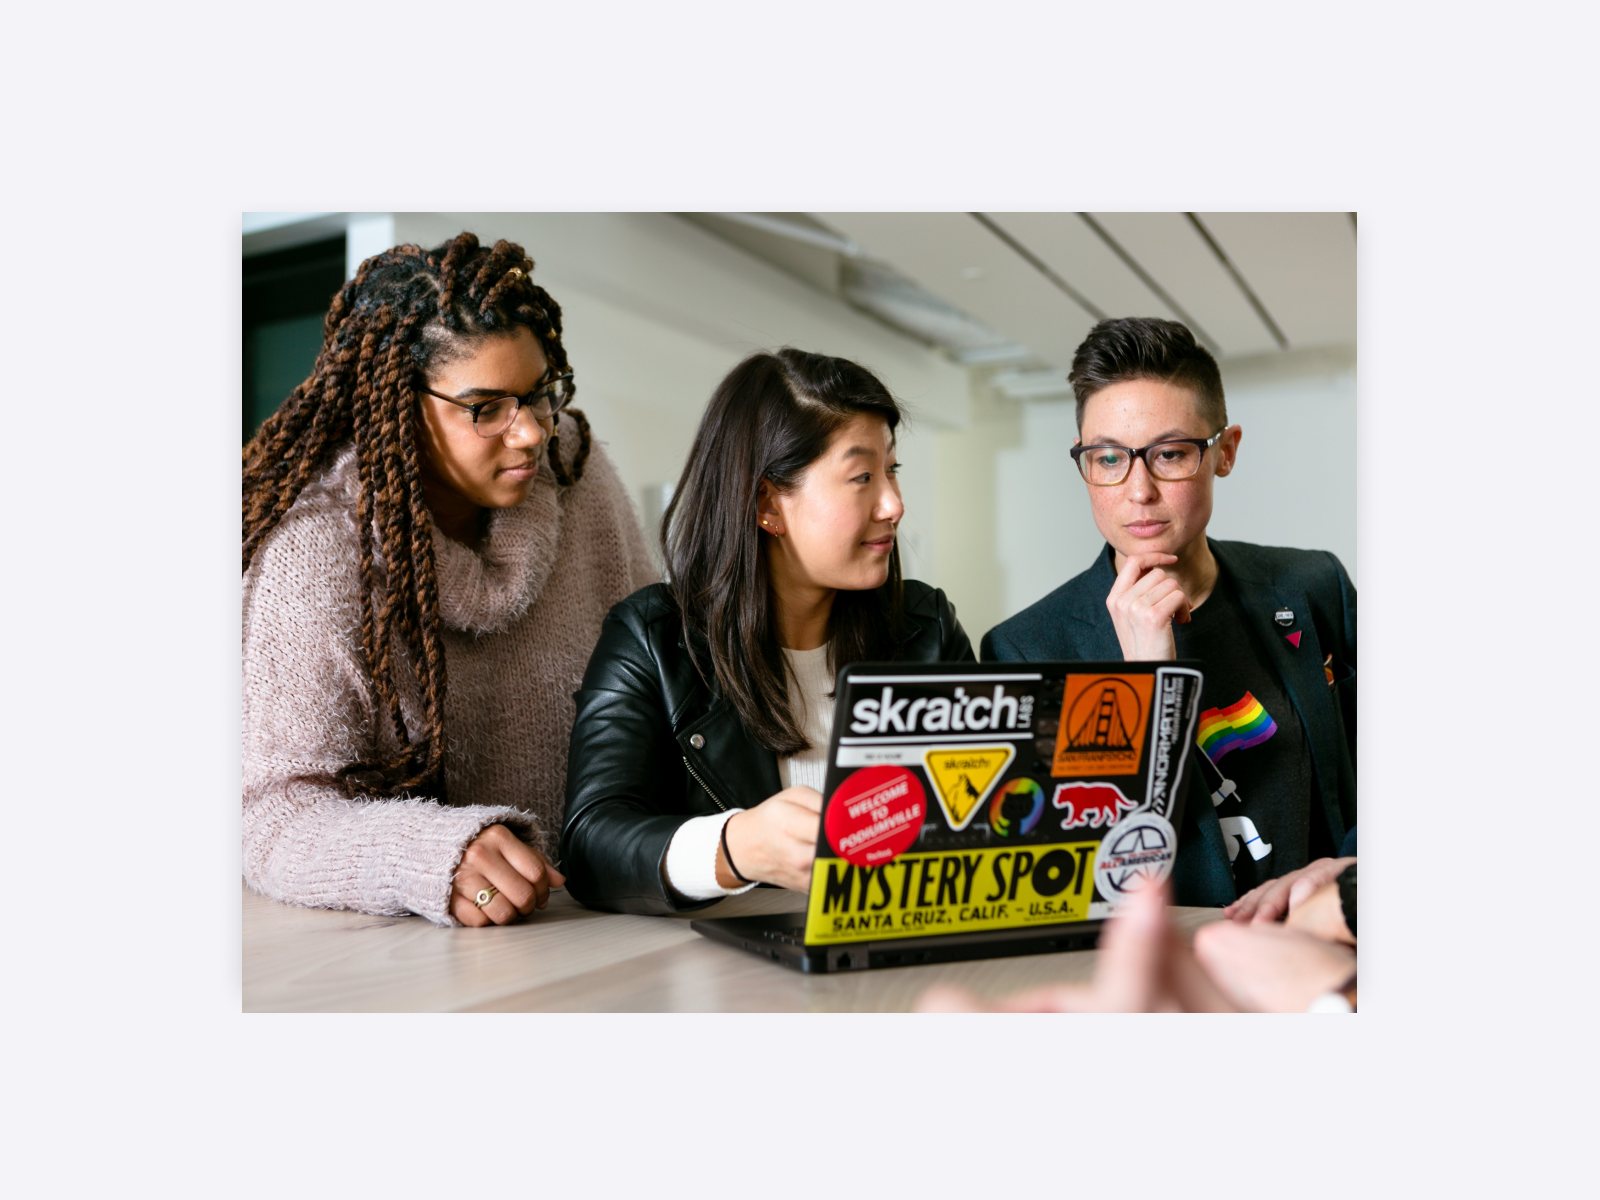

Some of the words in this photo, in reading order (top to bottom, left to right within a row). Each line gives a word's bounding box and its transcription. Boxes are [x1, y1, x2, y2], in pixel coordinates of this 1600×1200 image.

[850, 685, 1018, 734] skratch
[1017, 695, 1035, 729] LABS
[848, 781, 909, 819] WELCOME
[870, 805, 888, 822] TO
[839, 803, 921, 852] PODIUMVILLE
[822, 853, 984, 914] MYSTERY
[985, 846, 1096, 902] SPOT
[832, 914, 893, 932] SANTA
[901, 909, 952, 927] CRUZ,
[959, 904, 1009, 921] CALIF.
[1029, 901, 1074, 916] U.S.A.
